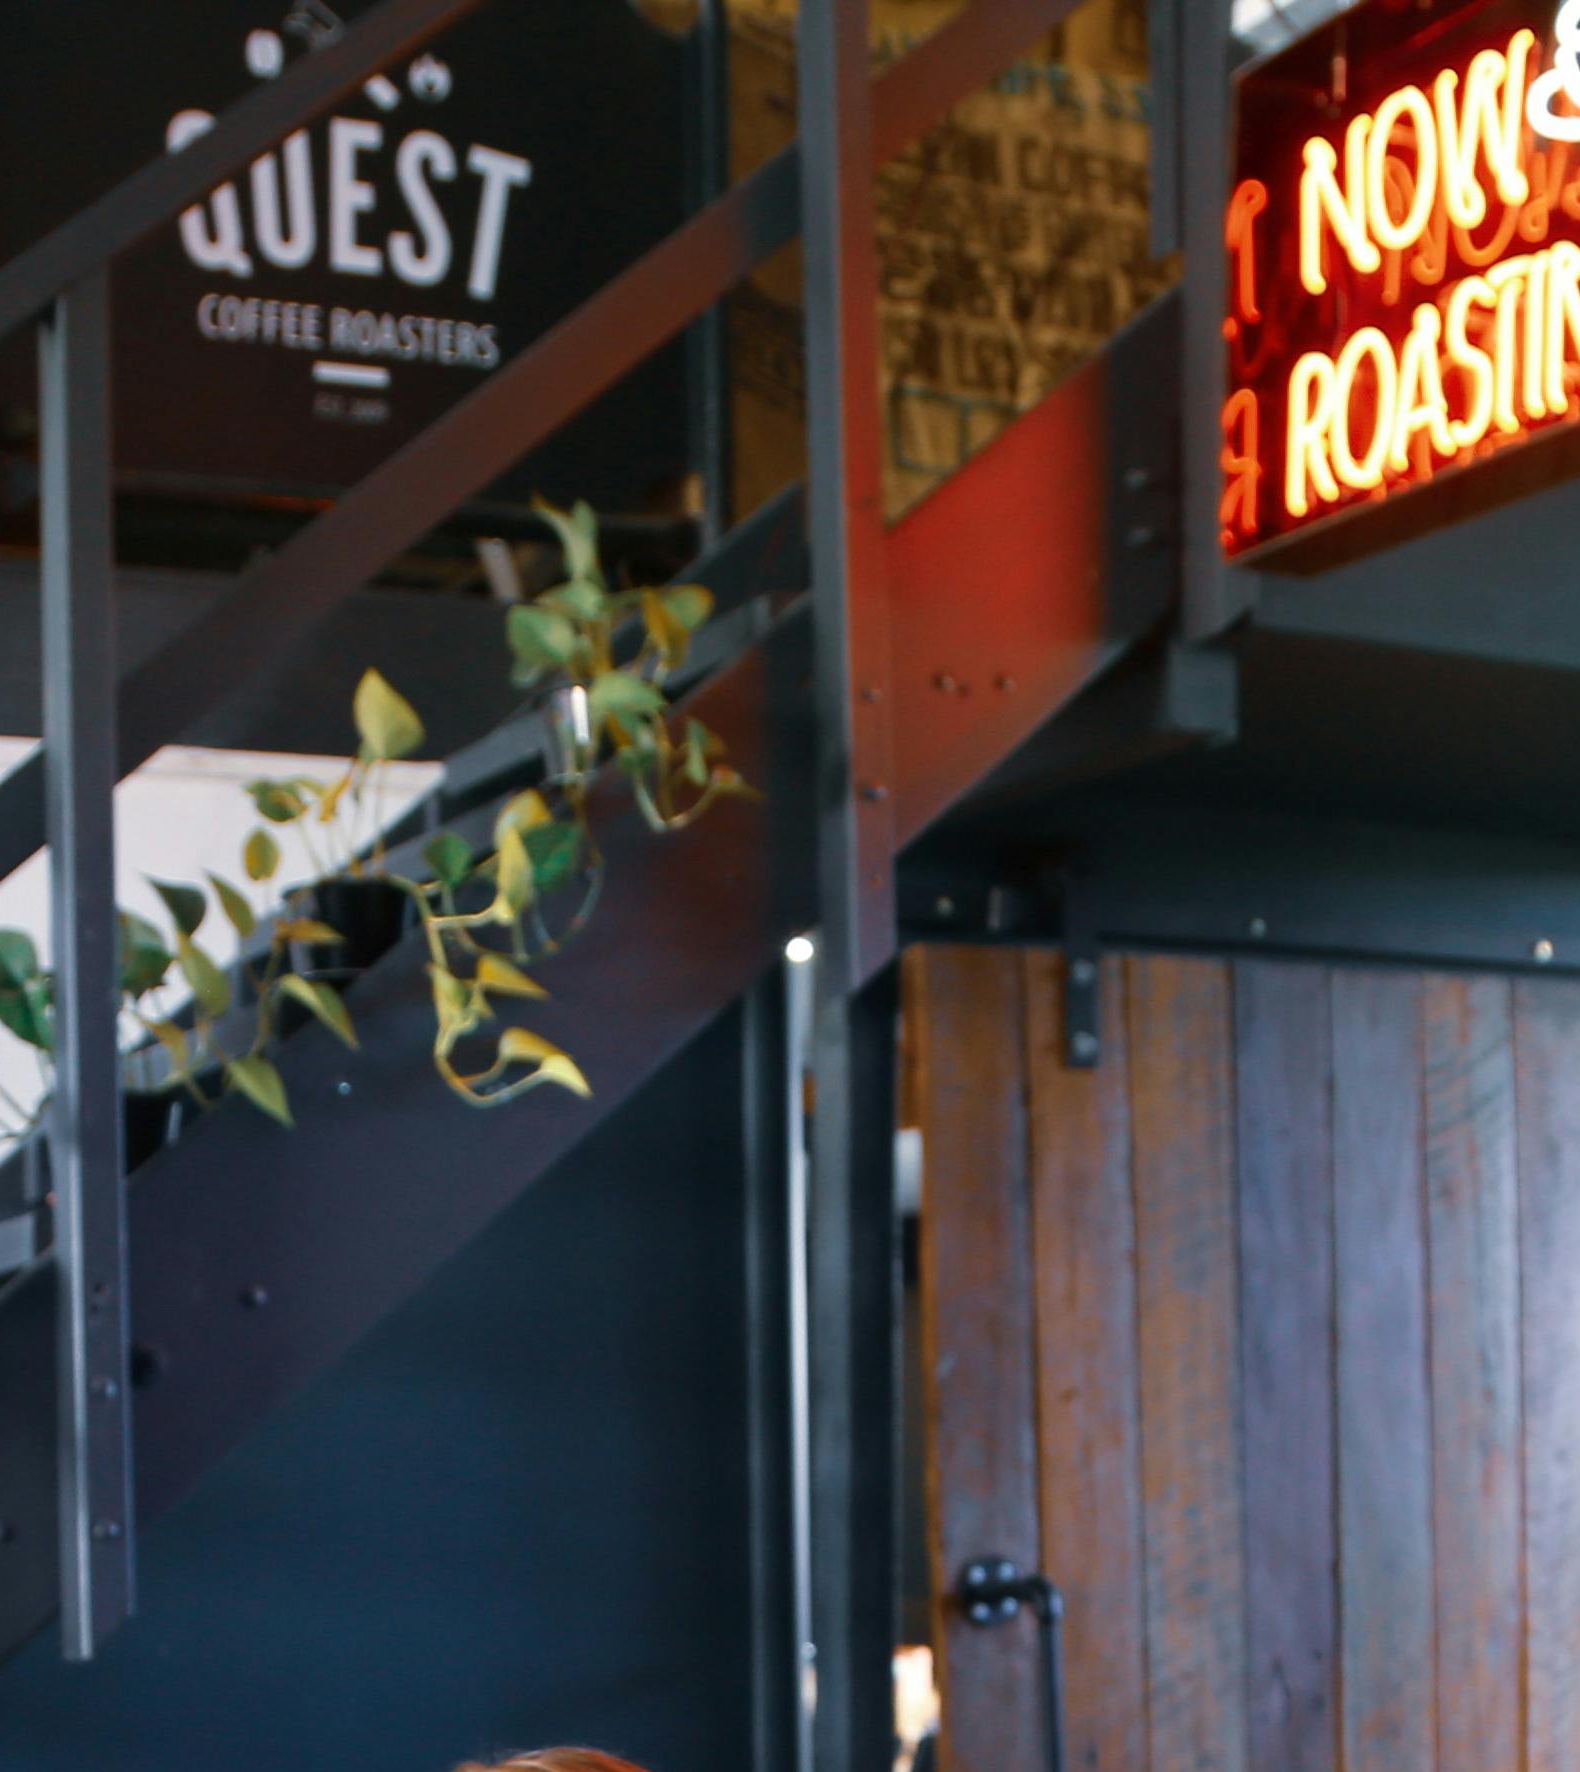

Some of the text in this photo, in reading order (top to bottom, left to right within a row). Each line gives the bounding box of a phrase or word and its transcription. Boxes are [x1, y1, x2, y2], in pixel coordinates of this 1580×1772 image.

[1299, 27, 1536, 296] NOW
[196, 292, 501, 369] COFFEE ROASTERS
